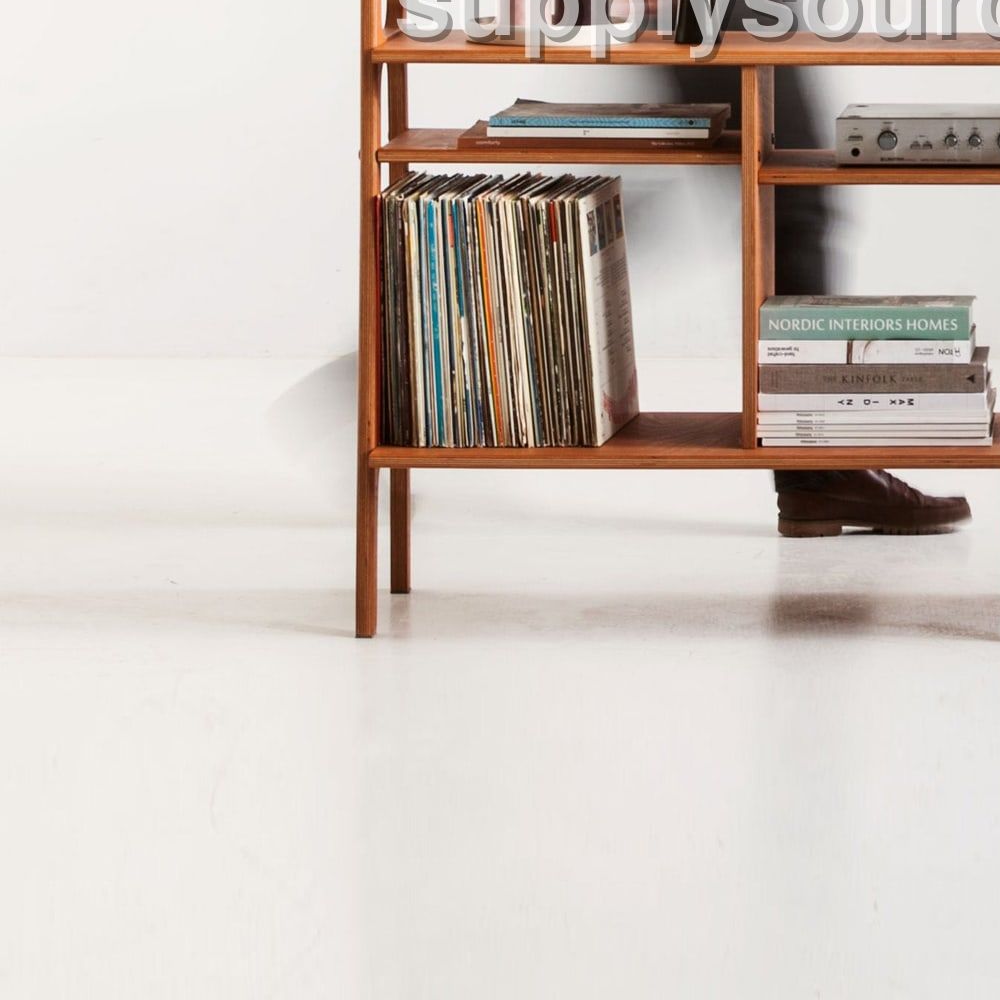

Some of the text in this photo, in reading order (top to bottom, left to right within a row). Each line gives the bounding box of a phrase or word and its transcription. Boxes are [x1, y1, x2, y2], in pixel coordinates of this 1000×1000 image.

[767, 318, 959, 331] NORDIC INTERIORS HOMES
[841, 375, 897, 384] KINFOLK
[889, 398, 914, 406] MAX
